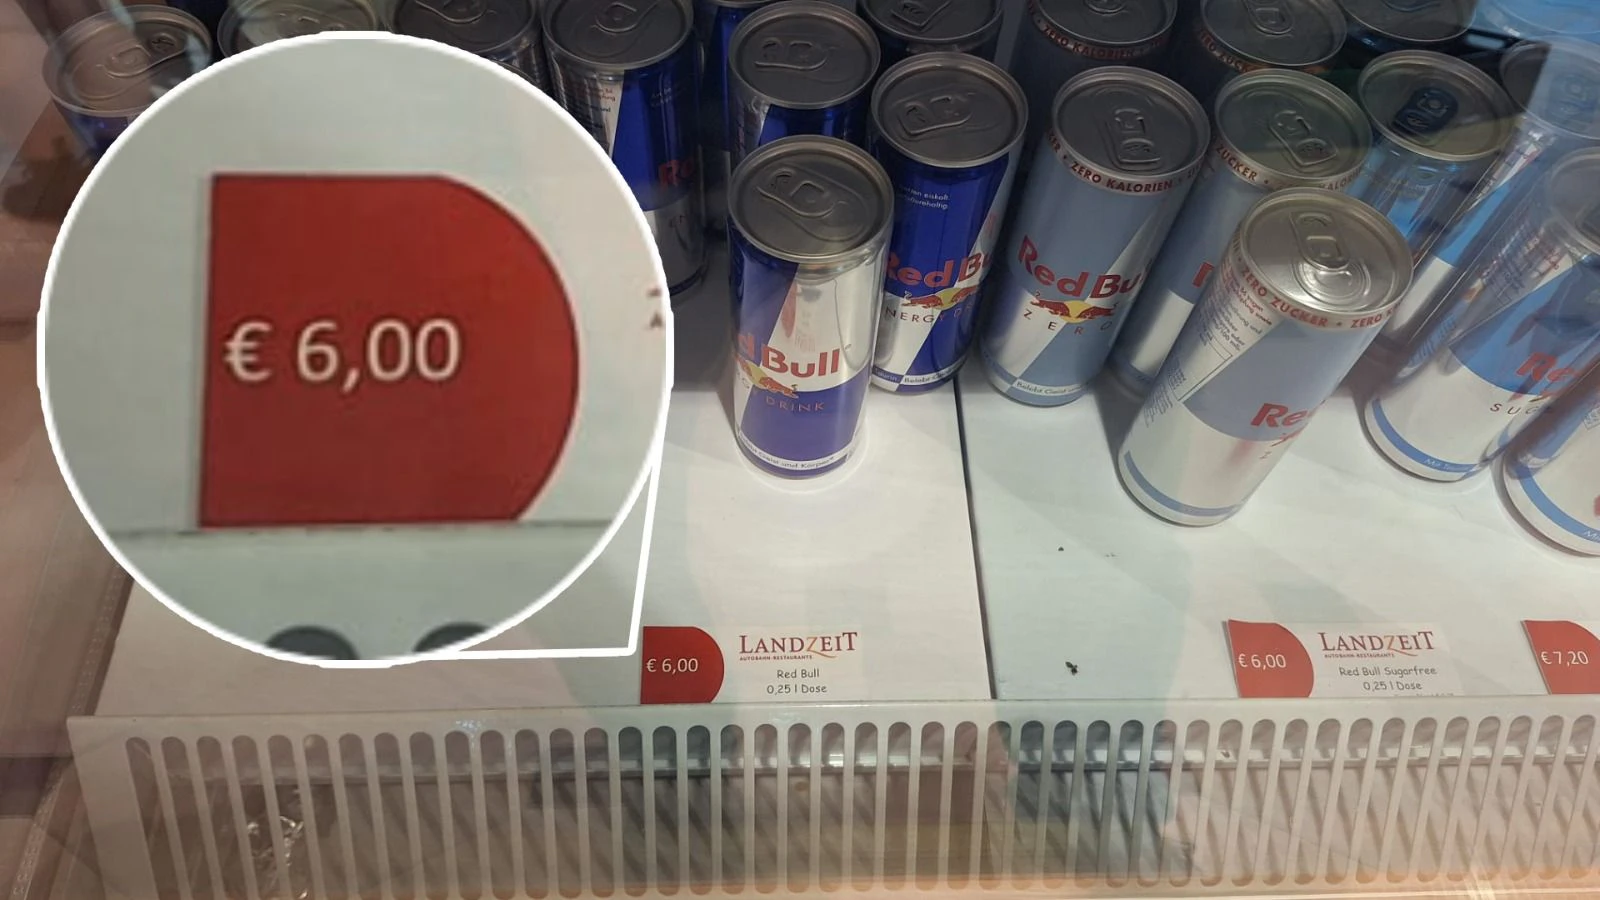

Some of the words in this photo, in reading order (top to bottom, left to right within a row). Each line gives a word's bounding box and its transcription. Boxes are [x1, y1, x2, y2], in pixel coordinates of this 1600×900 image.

[1216, 144, 1259, 182] ZUCKER
[1070, 161, 1102, 184] ZERO
[1106, 179, 1174, 194] KALORIEN
[1018, 234, 1090, 297] Red
[1242, 266, 1269, 297] ZERO
[1270, 297, 1329, 328] ZUCKER
[1023, 309, 1113, 336] ZERO
[1350, 313, 1383, 330] ZERO
[224, 321, 272, 382] €
[297, 317, 460, 394] 6,00
[761, 345, 841, 378] Bull
[765, 396, 825, 412] DRINK
[739, 632, 858, 657] LANDZEIT
[1318, 631, 1434, 656] LANDZEIT
[646, 658, 657, 673] €
[661, 658, 699, 675] 6,00
[1238, 653, 1248, 668] €
[1251, 653, 1287, 670] 6,00
[1541, 650, 1552, 665] €
[1552, 650, 1589, 667] 7,20
[777, 669, 797, 679] Red
[800, 668, 820, 679] Bull
[1339, 666, 1360, 677] Red
[1362, 666, 1381, 677] Bull
[1384, 666, 1437, 679] Sugarfree
[766, 684, 791, 695] 0,25
[801, 683, 828, 694] Dose
[1362, 681, 1387, 692] 0,25
[1396, 681, 1423, 691] Dose
